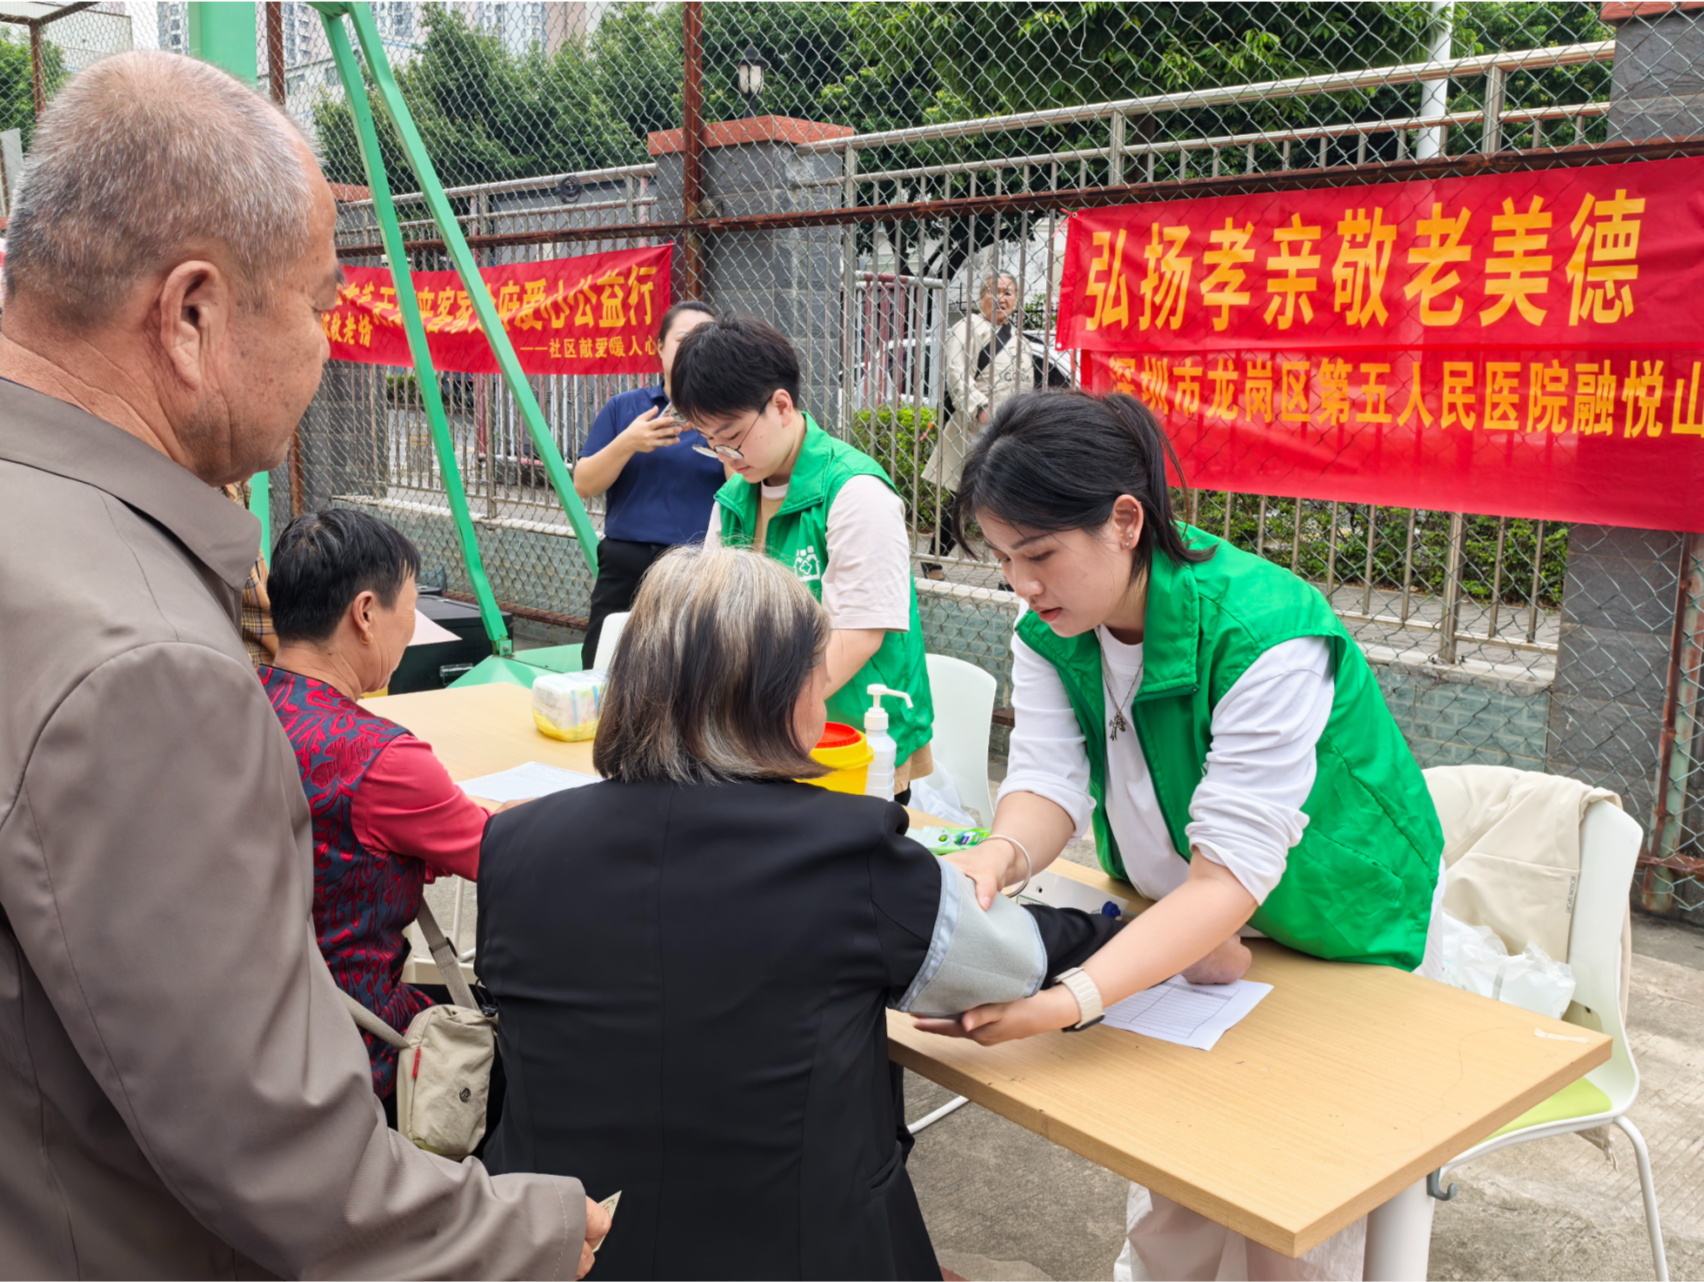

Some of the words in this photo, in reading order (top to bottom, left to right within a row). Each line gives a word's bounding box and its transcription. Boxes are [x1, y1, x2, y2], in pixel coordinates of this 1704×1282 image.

[1085, 189, 1647, 332] 弘扬孝亲敬老美德
